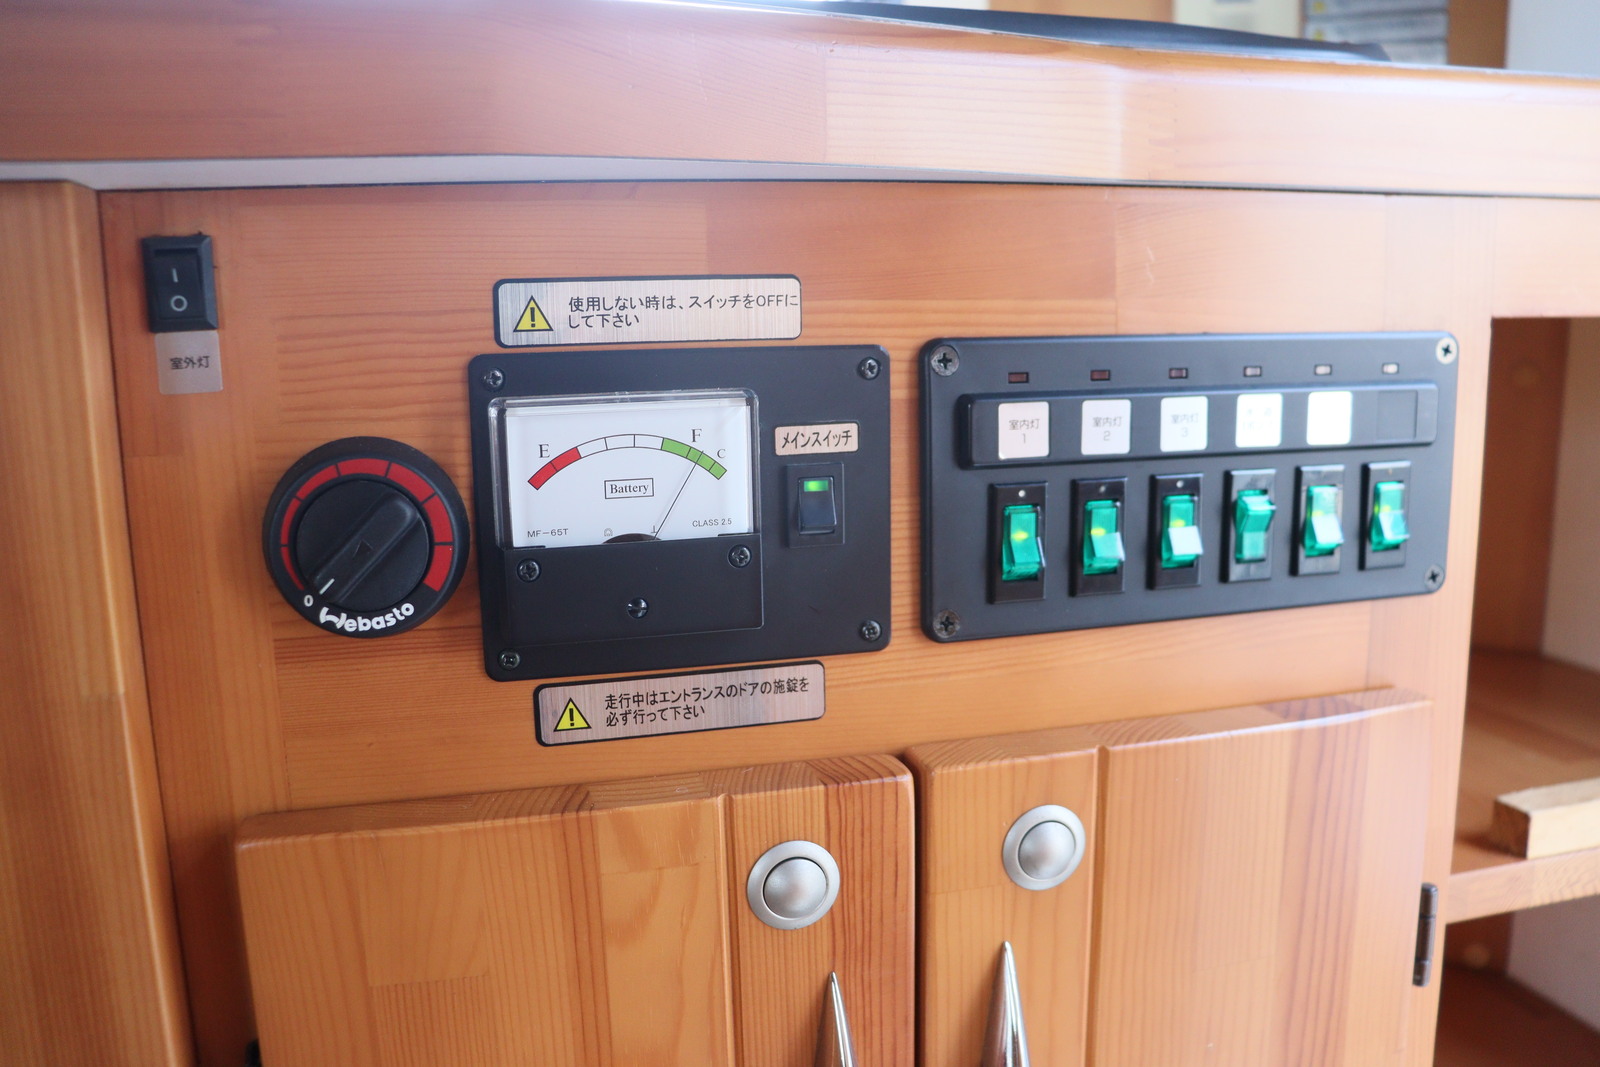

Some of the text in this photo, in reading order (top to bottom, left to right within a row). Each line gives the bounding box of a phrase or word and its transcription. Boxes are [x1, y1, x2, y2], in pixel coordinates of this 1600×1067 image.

[568, 293, 799, 313] 使用しない時は、スイッチをOFFに
[568, 312, 640, 329] して下さい
[169, 355, 211, 370] 室外灯
[1009, 418, 1040, 431] 室内灯
[1092, 416, 1123, 428] 室内灯
[691, 428, 702, 443] F
[781, 430, 853, 450] メインスイッチ
[1022, 433, 1027, 444] 1
[1102, 430, 1111, 441] 2
[538, 443, 550, 459] E
[716, 448, 727, 459] C
[609, 482, 650, 495] Battery
[692, 517, 732, 528] CLASS 2.5
[319, 602, 415, 632] Webasto
[605, 677, 809, 711] 走行中はエントランスのドアの施錠を
[605, 704, 706, 728] 必ず行って下さい
